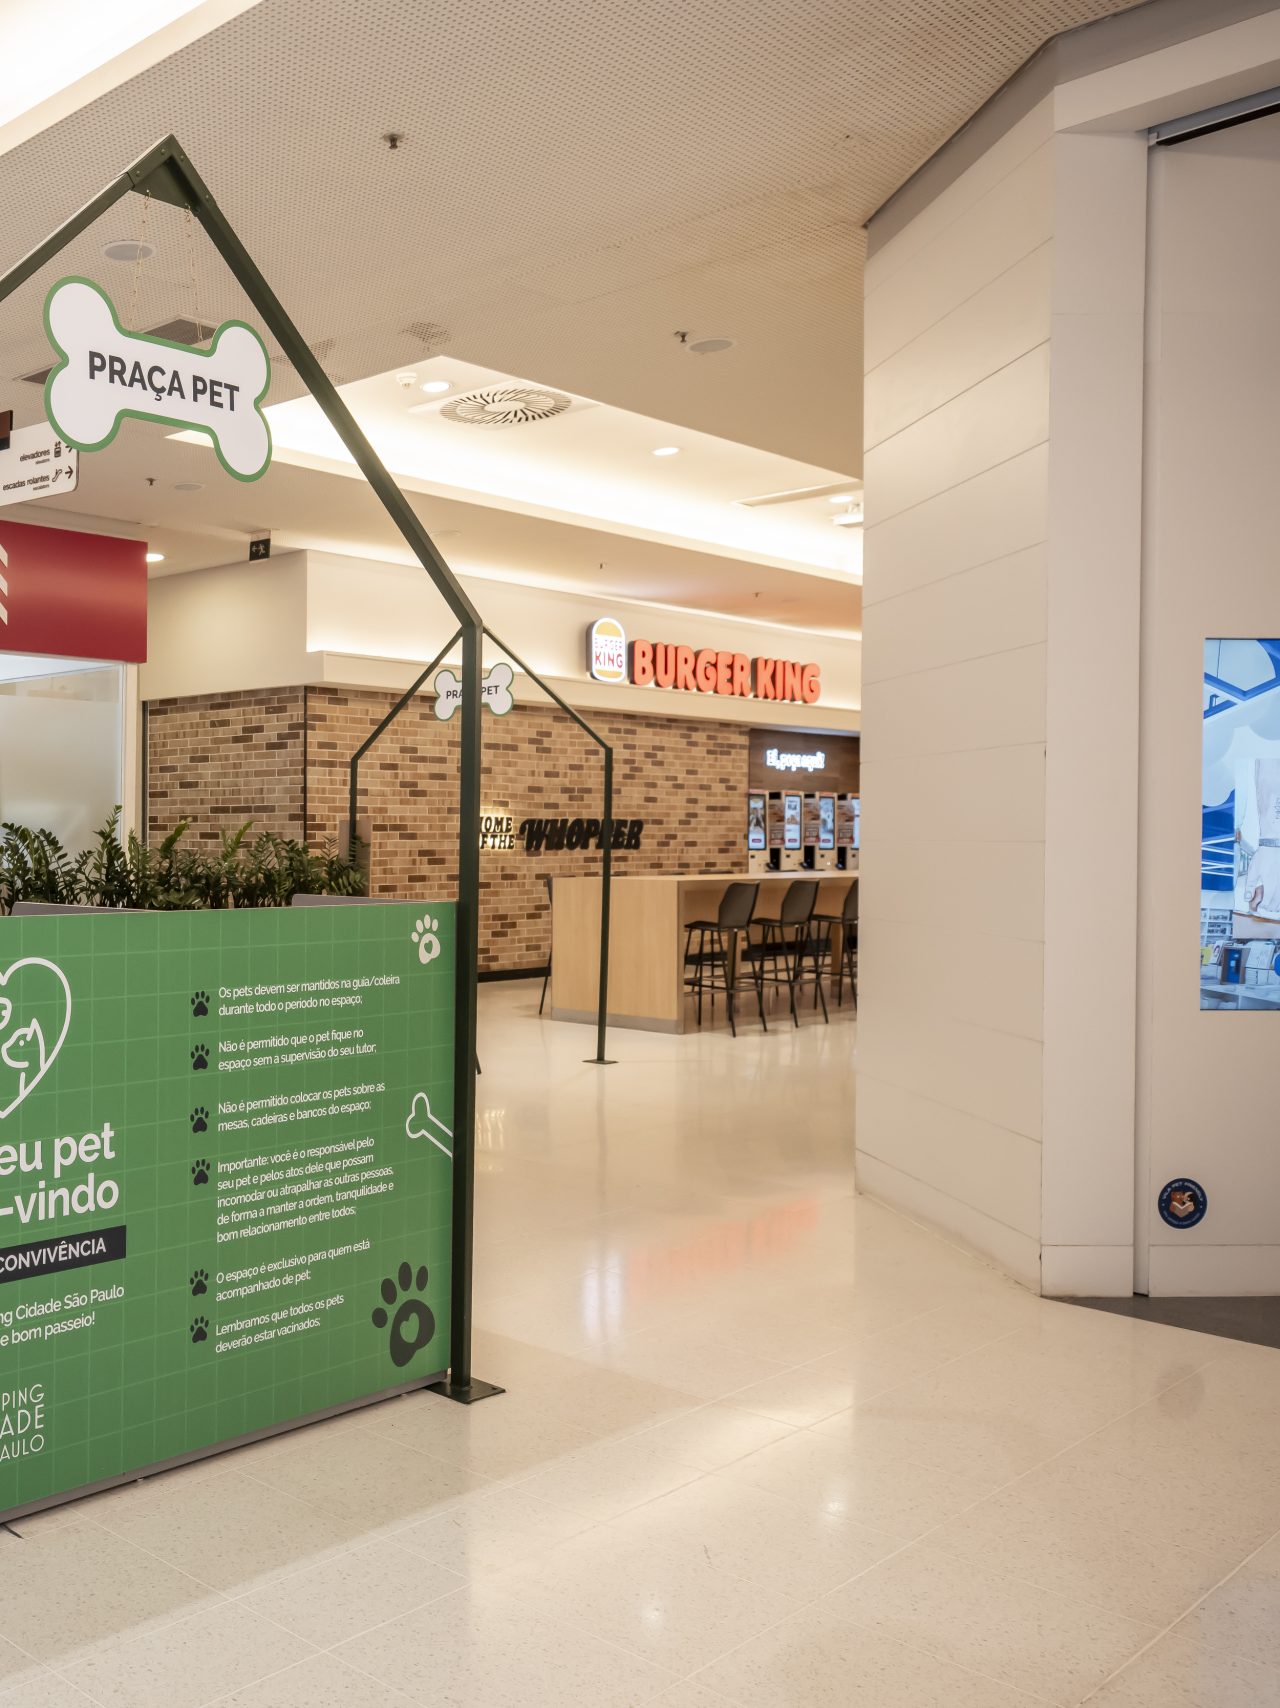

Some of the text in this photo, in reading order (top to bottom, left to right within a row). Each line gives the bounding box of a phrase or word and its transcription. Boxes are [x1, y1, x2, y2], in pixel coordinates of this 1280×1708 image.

[88, 350, 240, 411] PRAÇA PET
[19, 449, 50, 462] elevadores
[2, 481, 26, 491] escadas
[26, 475, 50, 486] rolantes
[594, 650, 623, 669] KING
[631, 638, 821, 705] BURGER KING
[489, 834, 515, 850] THE
[219, 974, 400, 1000] Os pets devem ser mantidos na guia/coleira
[219, 1003, 254, 1015] durante
[256, 1000, 276, 1012] todo
[278, 1002, 283, 1010] o
[320, 998, 330, 1006] no
[219, 1041, 237, 1052] Não
[239, 1040, 245, 1050] é
[247, 1035, 289, 1052] permitido
[291, 1036, 307, 1047] que
[316, 1031, 330, 1045] pet
[331, 1030, 352, 1042] fique
[353, 1030, 363, 1038] no
[218, 1059, 251, 1072] espaço
[253, 1056, 272, 1066] sem
[281, 1048, 326, 1064] supervisão
[328, 1046, 338, 1057] do
[340, 1047, 354, 1055] seu
[219, 1083, 385, 1114] Não é permitido colocar os pets sobre as
[218, 1120, 249, 1131] mesas,
[251, 1113, 288, 1126] cadeiras
[297, 1108, 327, 1119] bancos
[328, 1104, 339, 1114] do
[54, 1122, 116, 1179] pet
[218, 1156, 269, 1174] Importante:
[270, 1150, 291, 1163] você
[293, 1149, 298, 1159] é
[307, 1139, 356, 1158] responsável
[355, 1137, 374, 1151] pelo
[218, 1155, 373, 1190] seu pet e pelos atos dele que possam
[217, 1213, 229, 1225] de
[231, 1210, 257, 1222] forma
[259, 1208, 264, 1217] a
[267, 1201, 297, 1215] manter
[336, 1182, 387, 1201] tranquilidade
[218, 1190, 266, 1208] incomodar
[267, 1189, 278, 1198] ou
[280, 1180, 322, 1196] atrapalhar
[324, 1178, 333, 1187] as
[334, 1173, 360, 1185] outras
[217, 1231, 238, 1243] bom
[240, 1216, 307, 1237] relacionamento
[309, 1211, 330, 1223] entre
[216, 1239, 370, 1283] O espaço é exclusivo para quem está
[16, 1299, 61, 1319] Cidade
[64, 1293, 87, 1309] São
[91, 1285, 124, 1303] Paulo
[216, 1277, 281, 1301] acompanhado
[282, 1274, 294, 1285] de
[0, 1335, 9, 1346] e
[12, 1327, 41, 1344] bom
[45, 1311, 95, 1340] passeio!
[216, 1295, 344, 1335] Lembramos que todos os pets
[216, 1335, 252, 1353] deverão
[254, 1329, 276, 1342] estar
